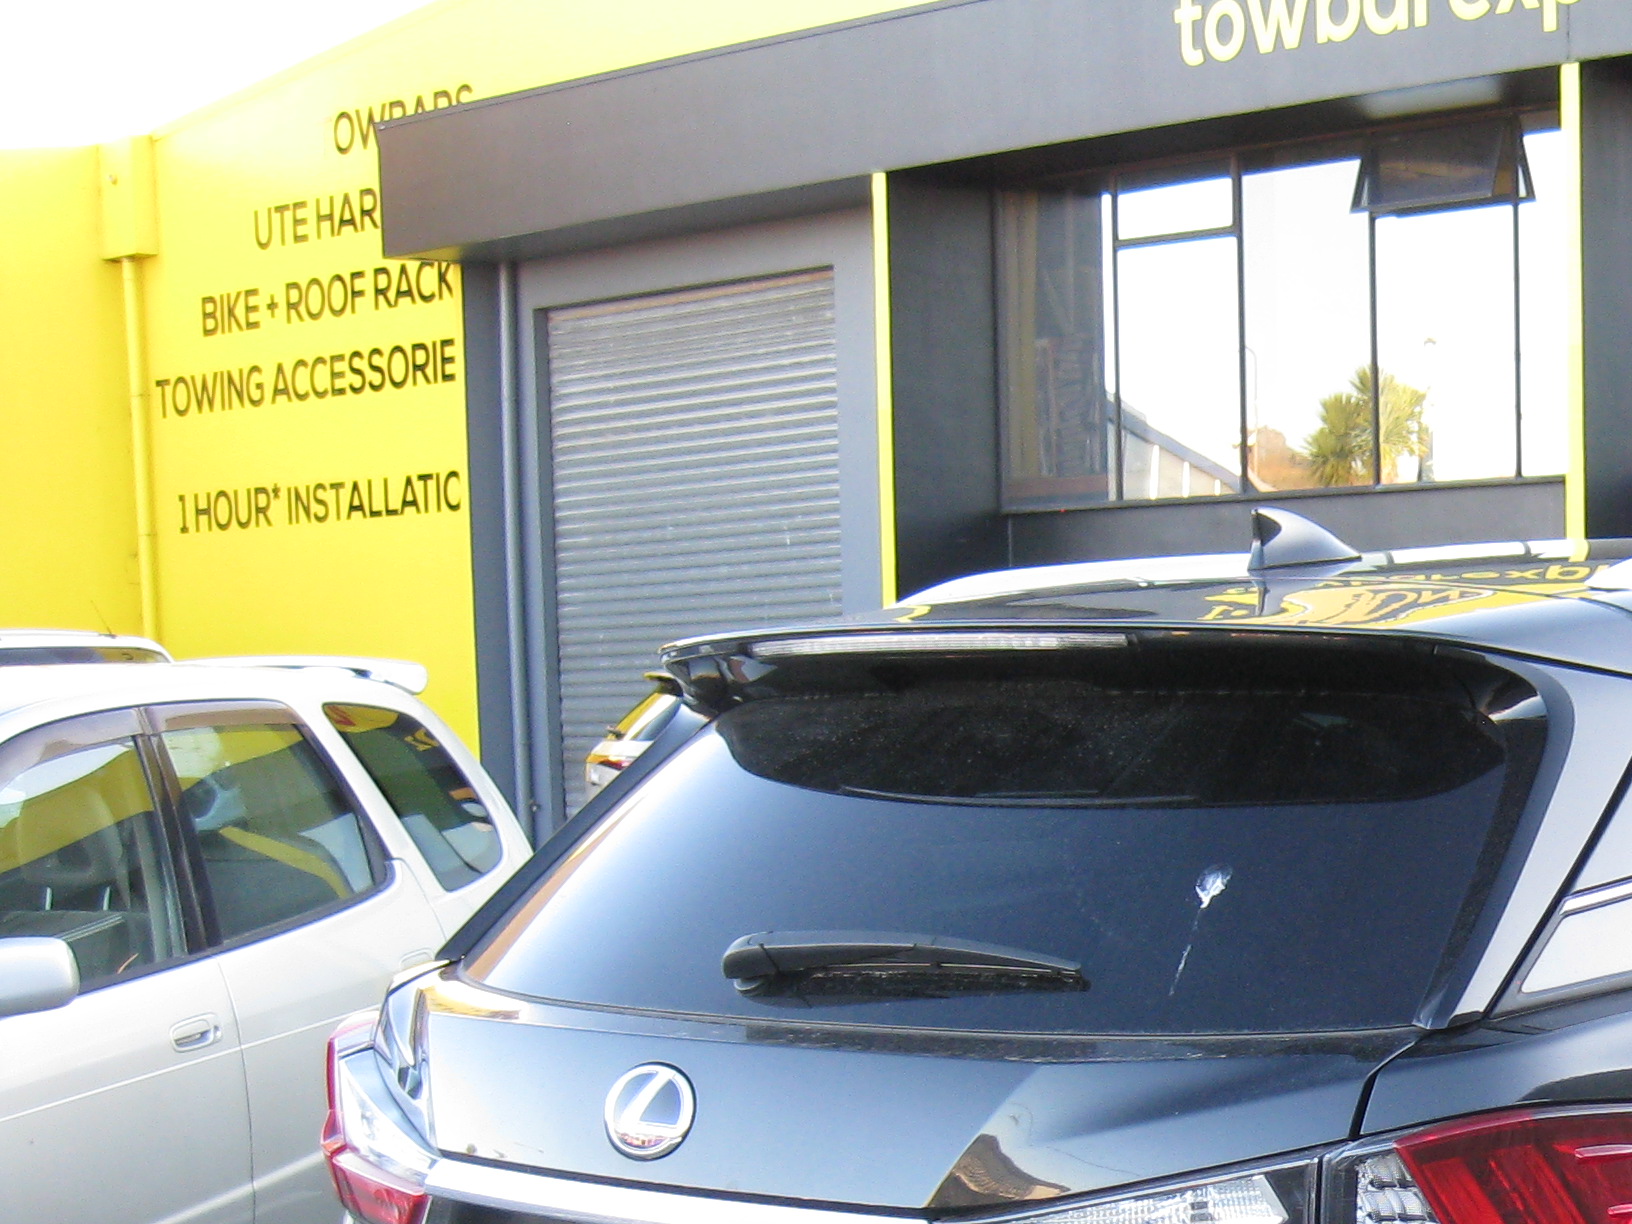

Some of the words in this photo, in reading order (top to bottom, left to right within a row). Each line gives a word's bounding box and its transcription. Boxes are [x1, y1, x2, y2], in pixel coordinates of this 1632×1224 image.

[1173, 0, 1580, 66] towbar
[254, 200, 309, 250] UTE
[315, 187, 380, 240] HAR
[201, 288, 261, 337] BIKE
[285, 270, 366, 325] ROOF
[373, 261, 454, 310] RACK
[155, 365, 265, 419] TOWING
[271, 338, 456, 405] ACCESSORIE
[177, 494, 190, 534] 1
